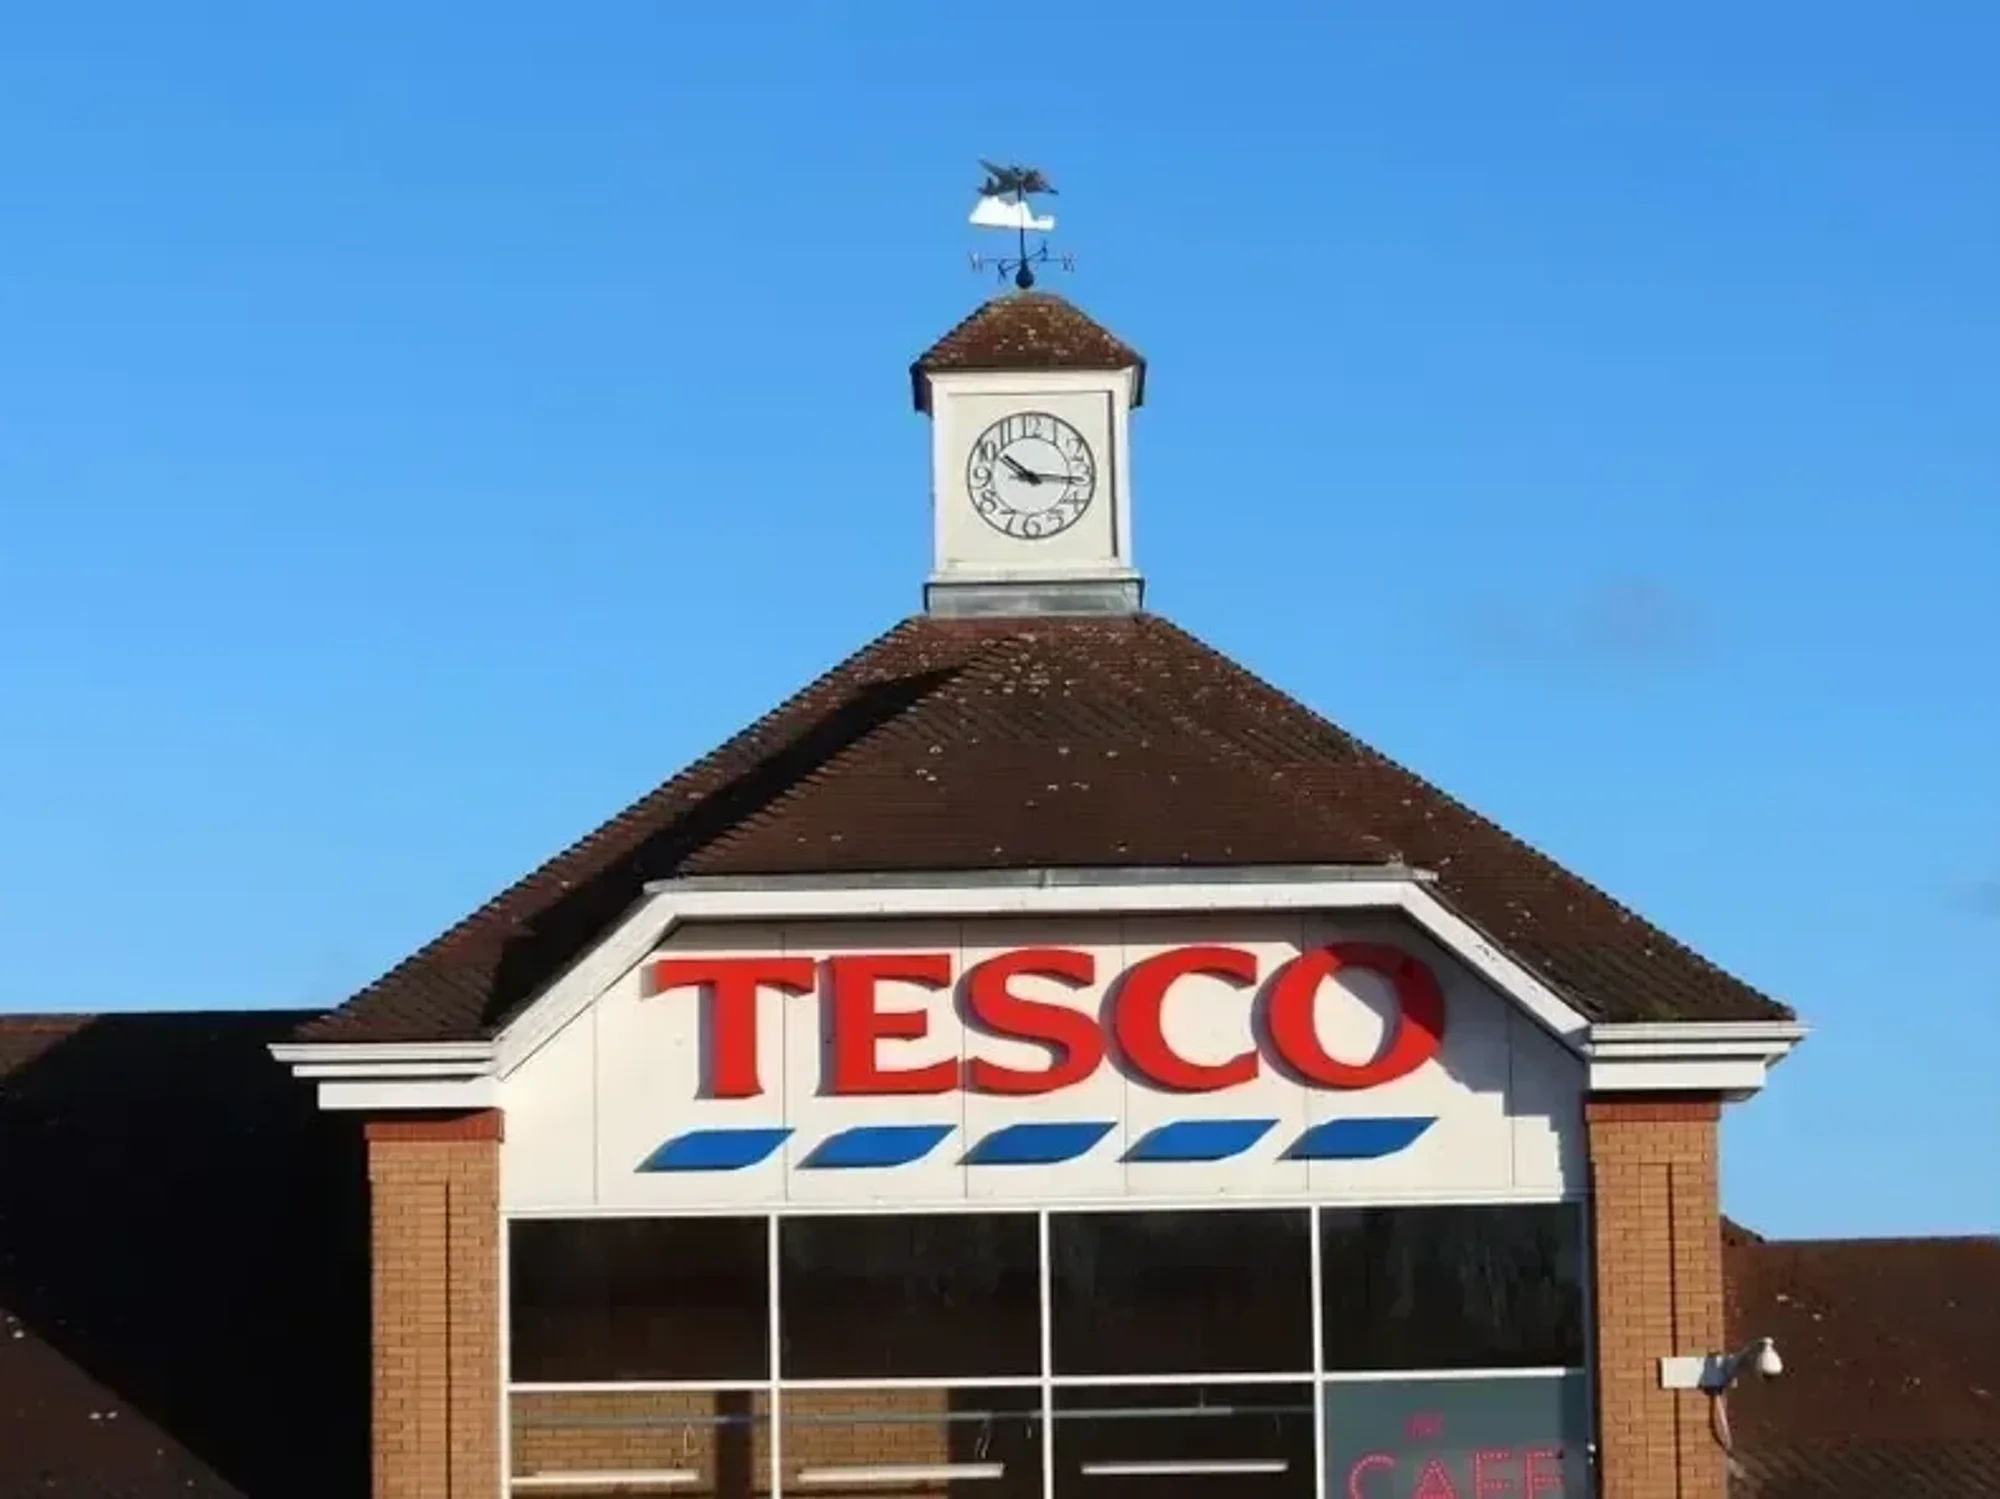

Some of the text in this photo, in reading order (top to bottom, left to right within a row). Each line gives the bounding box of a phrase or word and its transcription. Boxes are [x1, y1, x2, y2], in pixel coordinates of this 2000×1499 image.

[1022, 415, 1042, 438] 12
[1067, 437, 1085, 462] 2
[972, 466, 993, 490] 9
[979, 489, 997, 514] 8
[1060, 491, 1088, 513] 4
[1000, 509, 1018, 534] 7
[1022, 513, 1042, 538] 6
[1047, 509, 1065, 533] 5
[654, 940, 1445, 1099] TESCO
